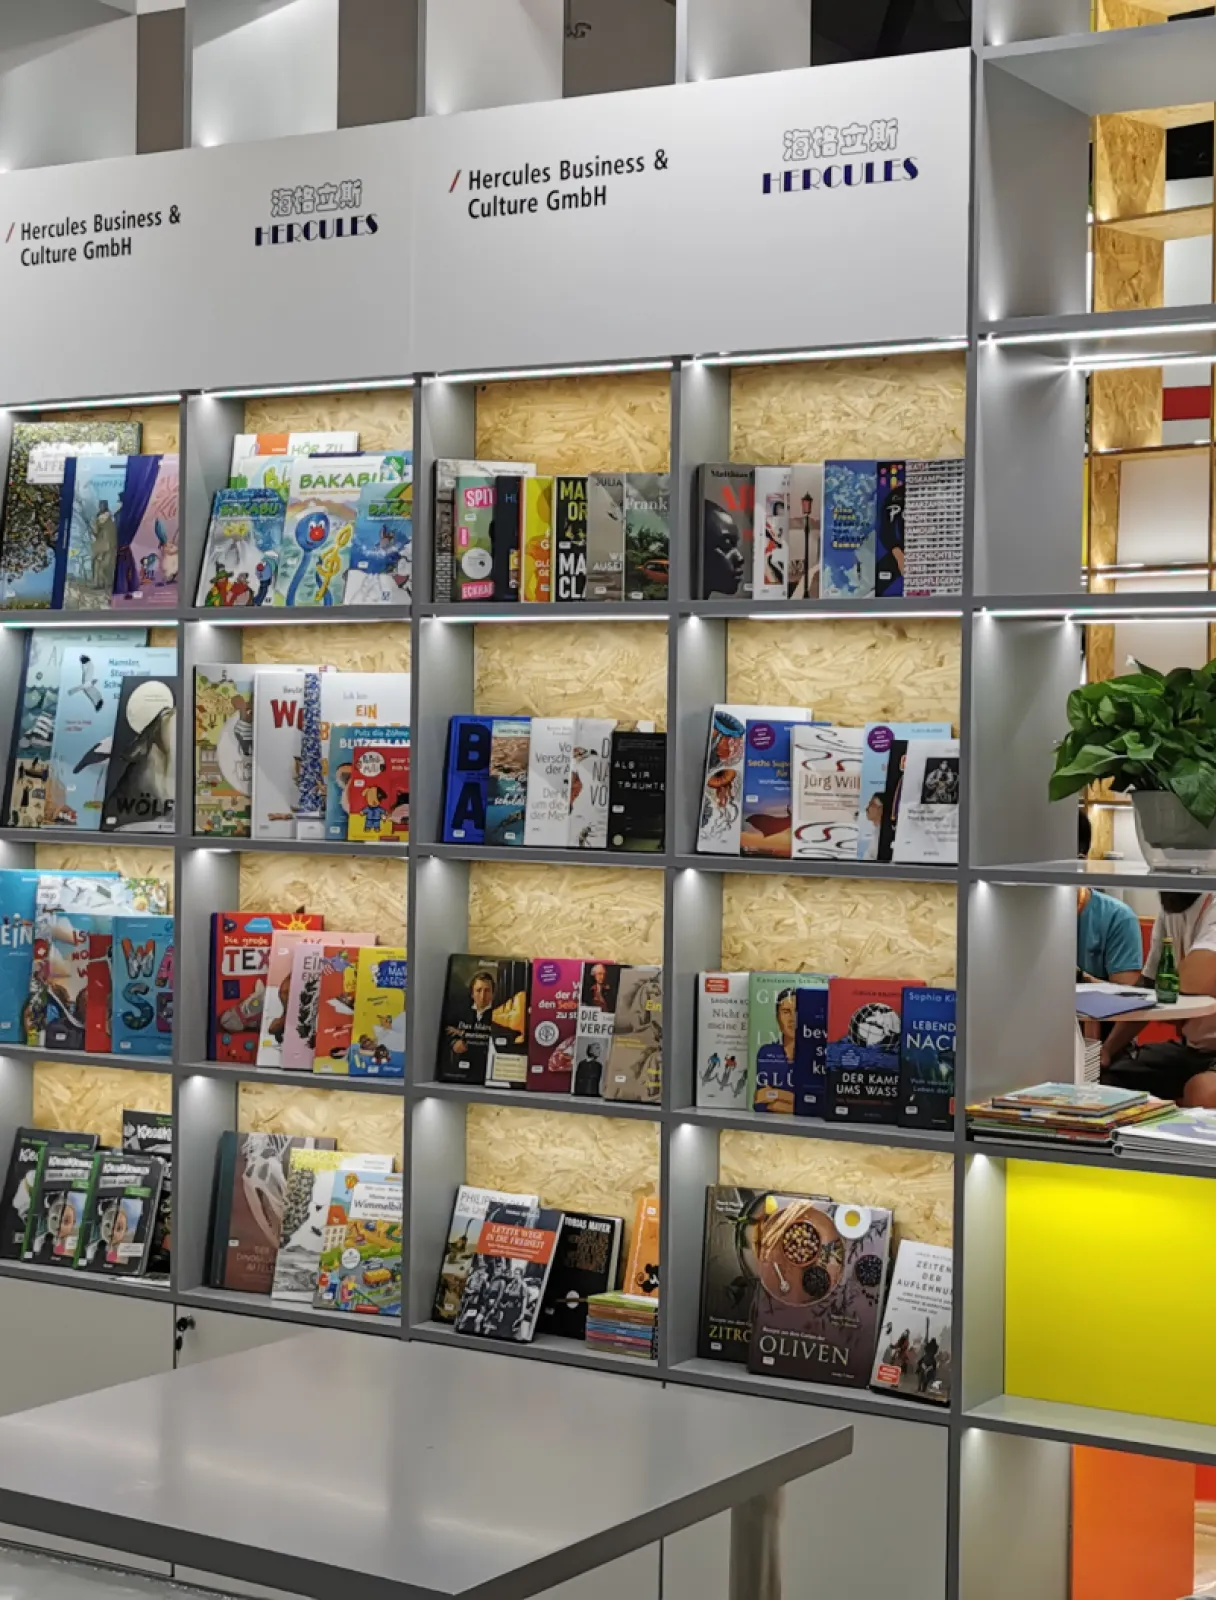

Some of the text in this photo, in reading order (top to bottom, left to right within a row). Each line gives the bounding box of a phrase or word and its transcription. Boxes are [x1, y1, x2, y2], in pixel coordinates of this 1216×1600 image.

[468, 149, 669, 191] Hercules Business &
[762, 157, 918, 194] HERCULES
[468, 185, 607, 219] Culture GmbH
[21, 205, 181, 241] Hercules Business &
[255, 214, 379, 246] HERCULES
[20, 236, 132, 267] Culture GmbH
[804, 774, 831, 790] Jürg
[836, 1084, 861, 1095] UMS
[842, 1073, 864, 1084] DER
[896, 1278, 953, 1296] AUFLEHNU
[759, 1335, 850, 1367] OLIVEN
